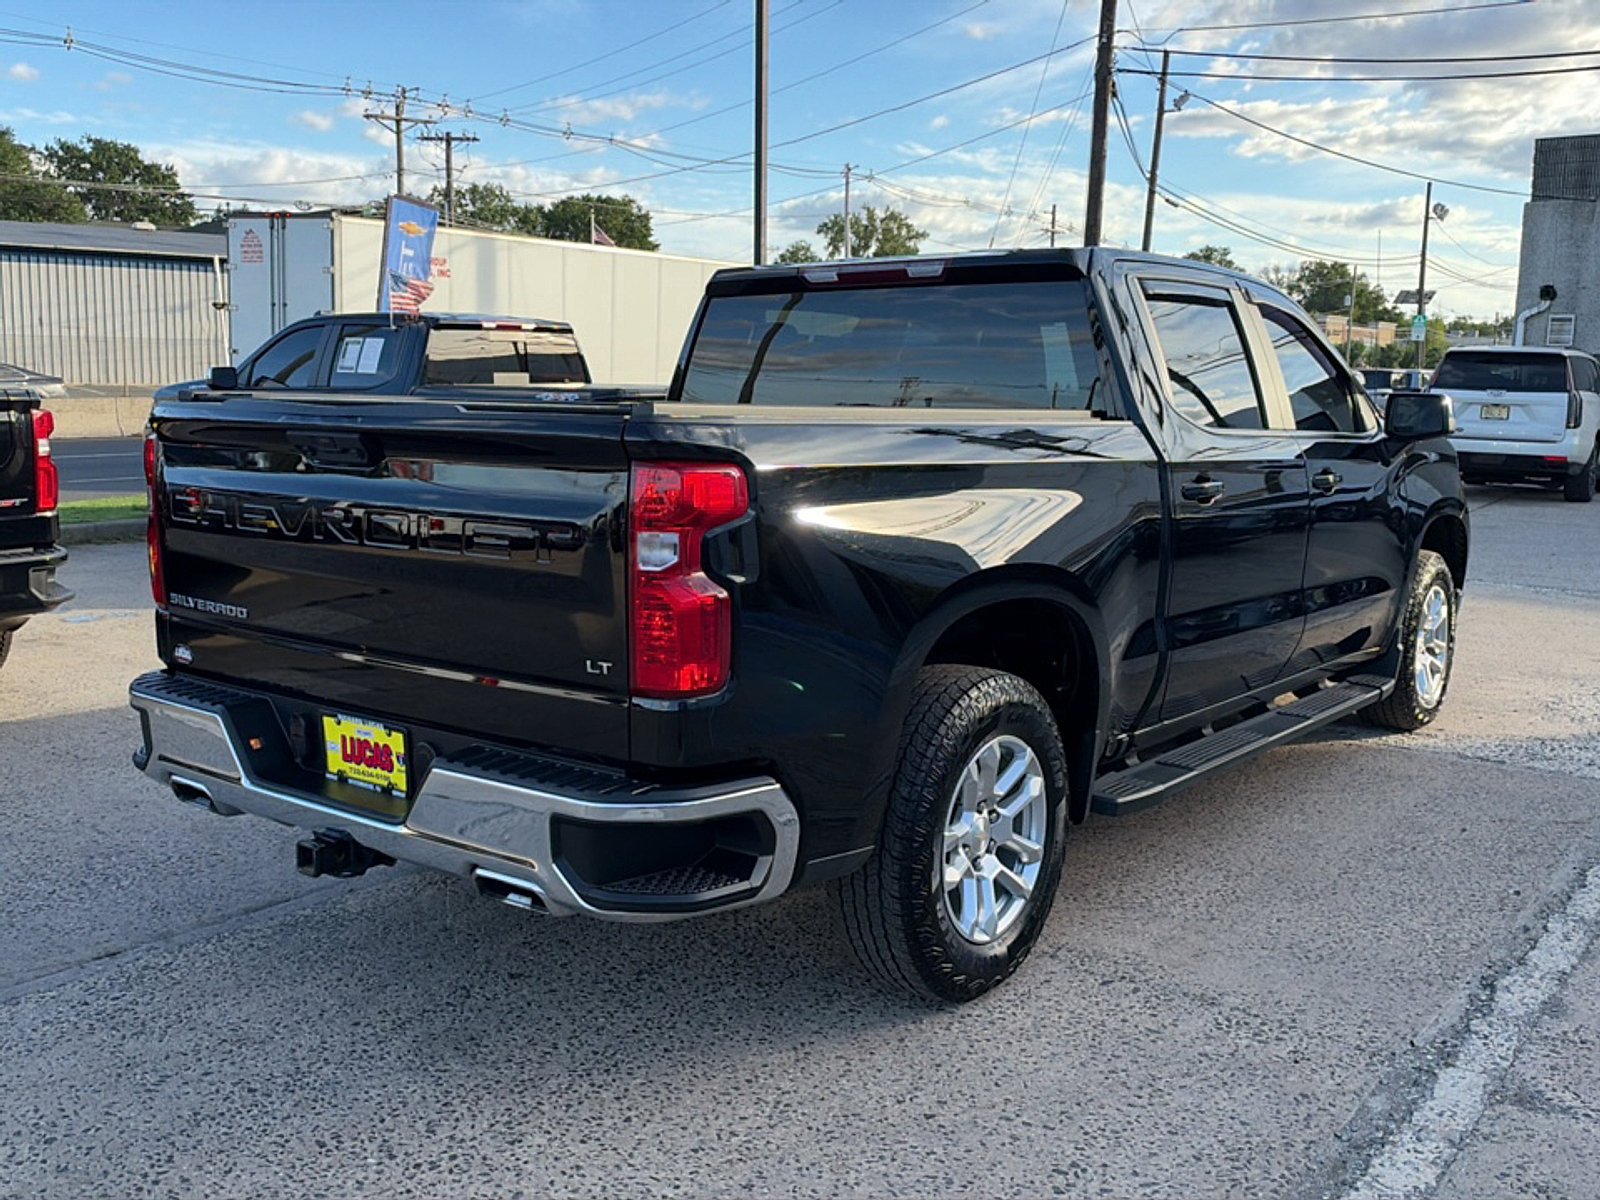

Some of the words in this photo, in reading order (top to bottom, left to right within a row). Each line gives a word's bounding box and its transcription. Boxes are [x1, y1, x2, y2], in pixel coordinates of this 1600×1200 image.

[171, 487, 584, 564] CHEVROLET
[170, 592, 248, 618] SILVERADO
[586, 660, 613, 675] LT
[341, 734, 394, 774] LUCAS
